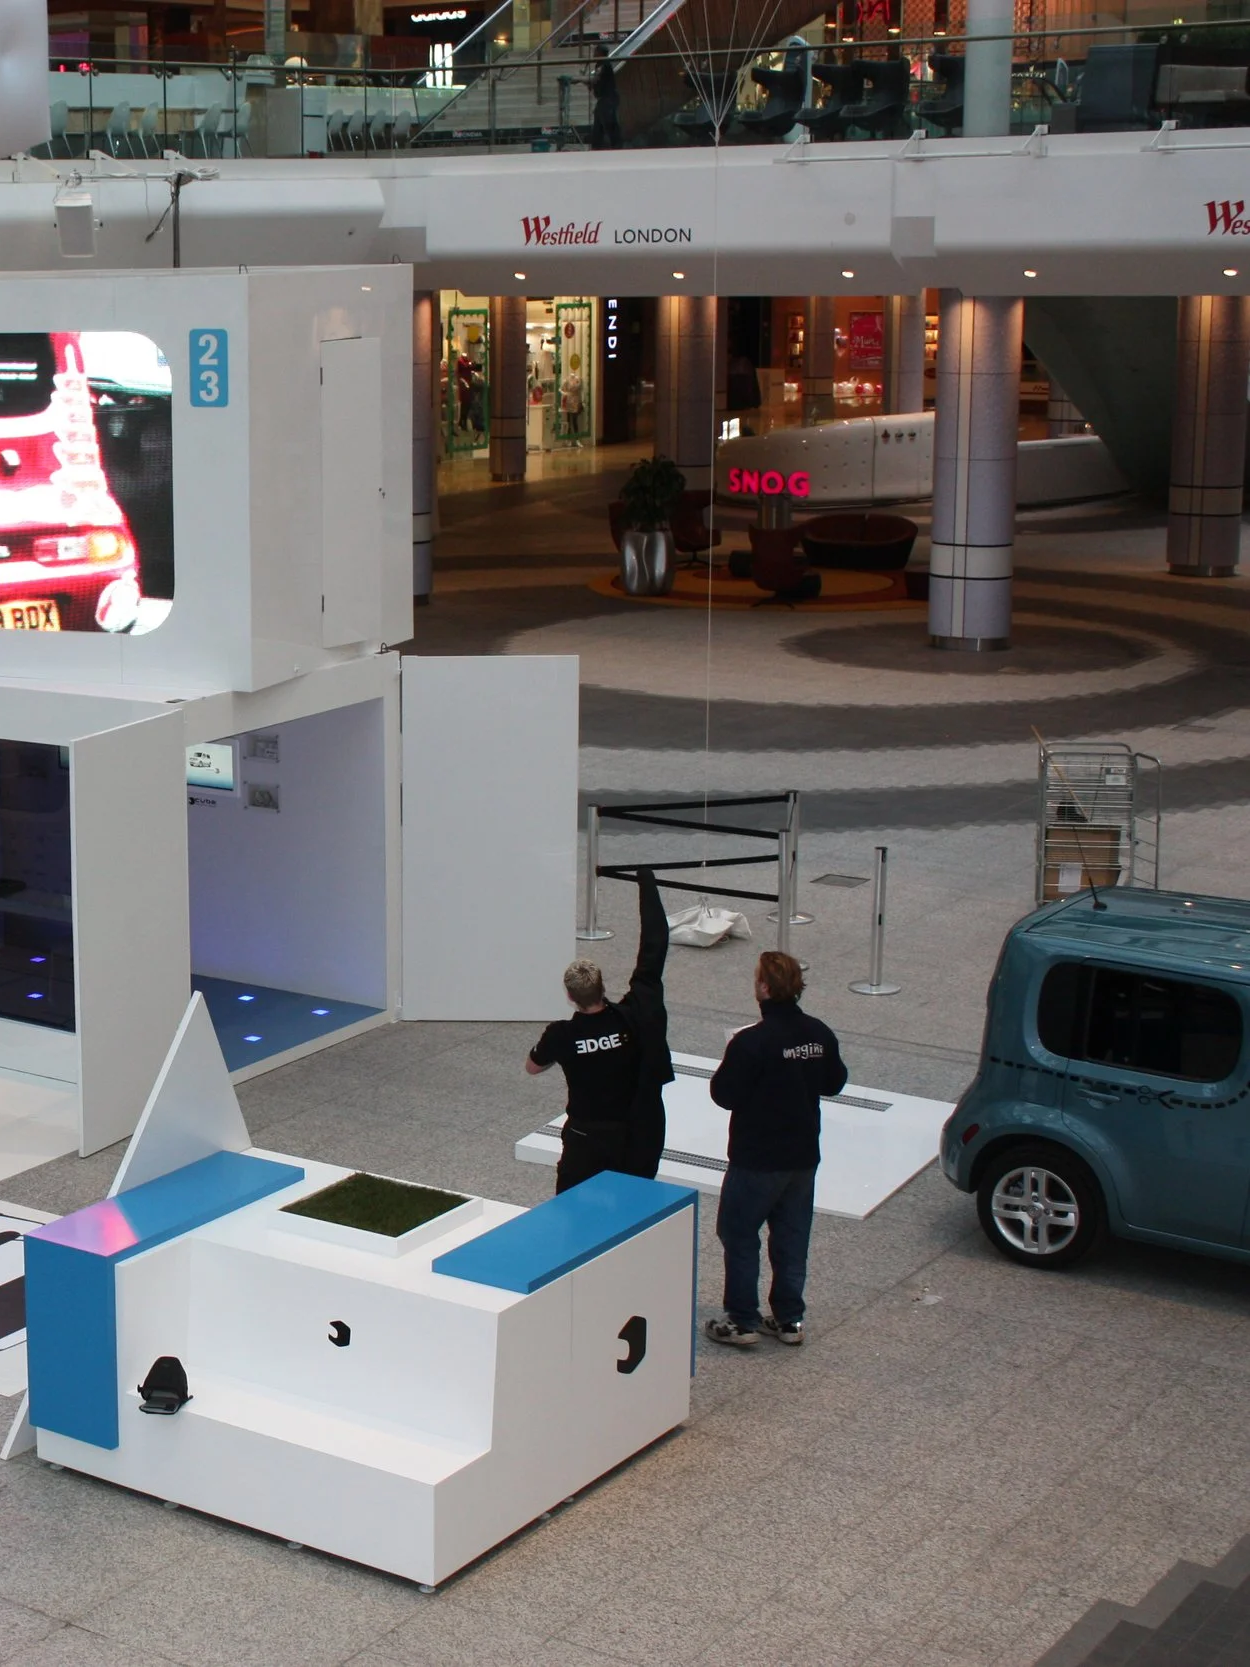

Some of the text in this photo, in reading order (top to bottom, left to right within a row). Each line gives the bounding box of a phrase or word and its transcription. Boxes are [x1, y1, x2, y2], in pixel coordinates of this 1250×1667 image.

[520, 215, 691, 246] Westfield LONDON
[729, 468, 810, 497] SNOG
